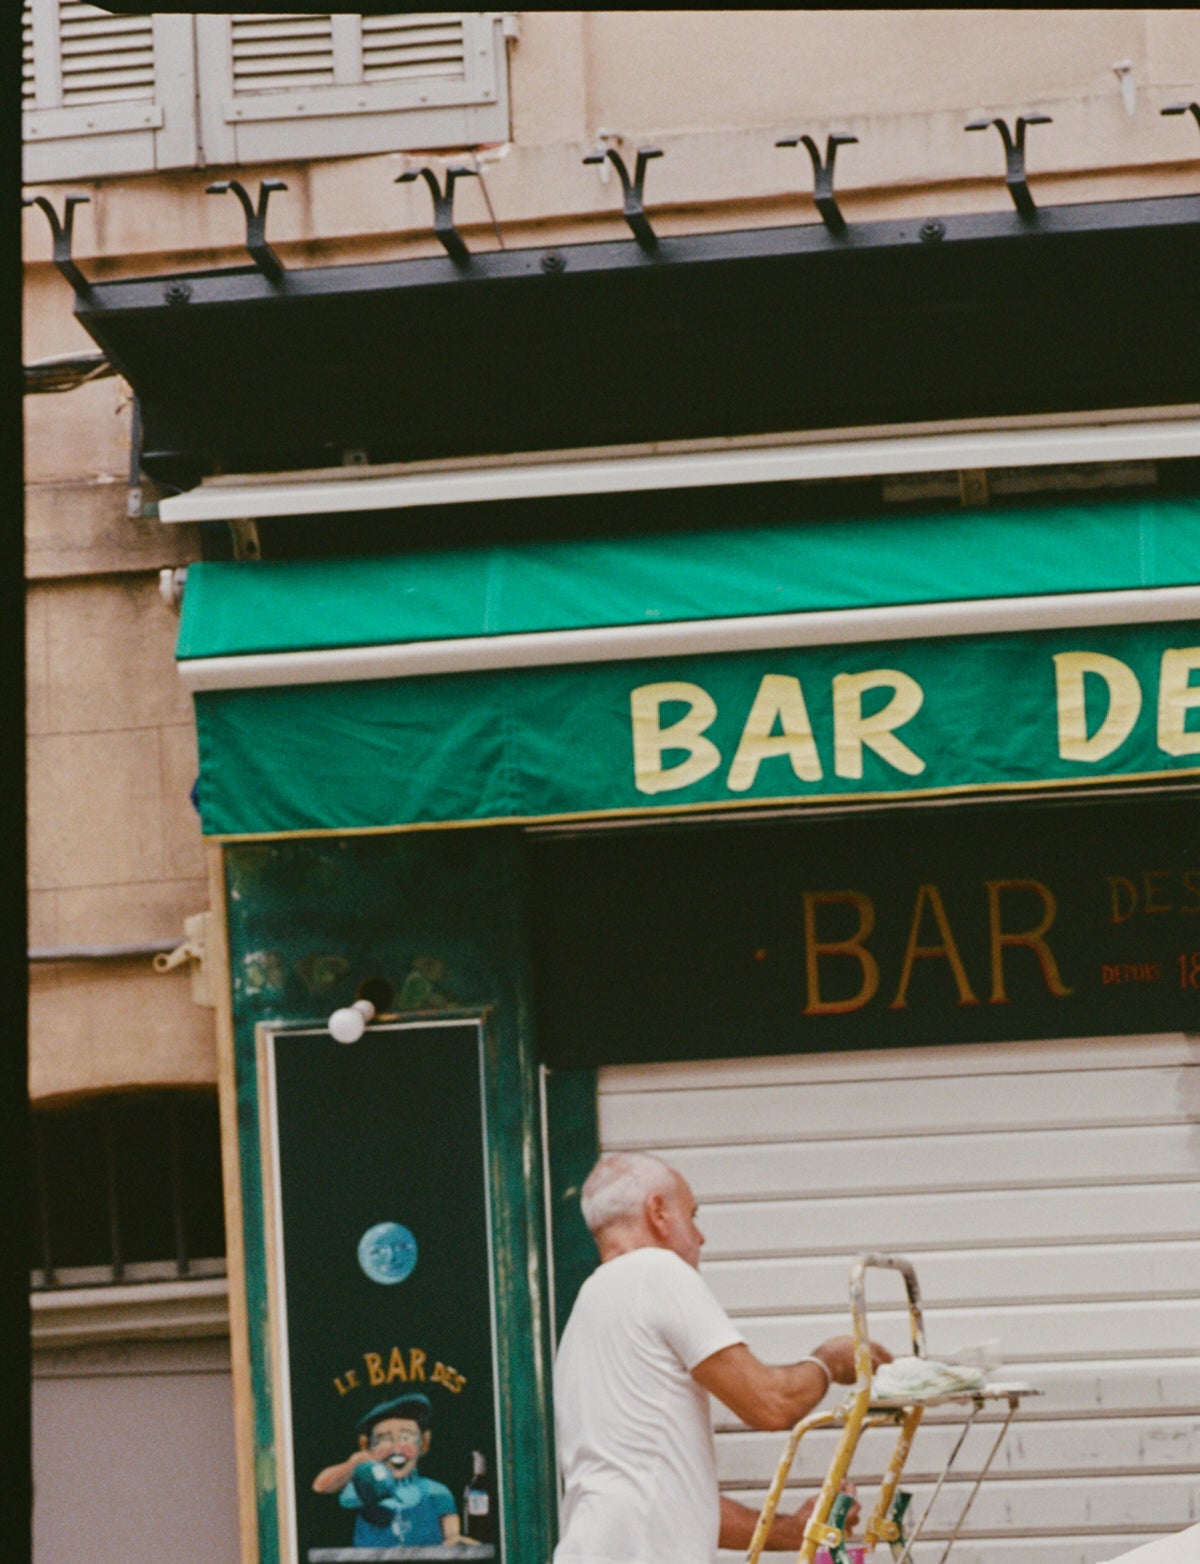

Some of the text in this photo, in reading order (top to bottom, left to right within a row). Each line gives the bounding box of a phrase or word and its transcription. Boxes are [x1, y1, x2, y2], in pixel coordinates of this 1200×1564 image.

[631, 668, 927, 796] BAR
[801, 878, 1074, 1017] BAR
[334, 1346, 468, 1396] LE BAR DES
